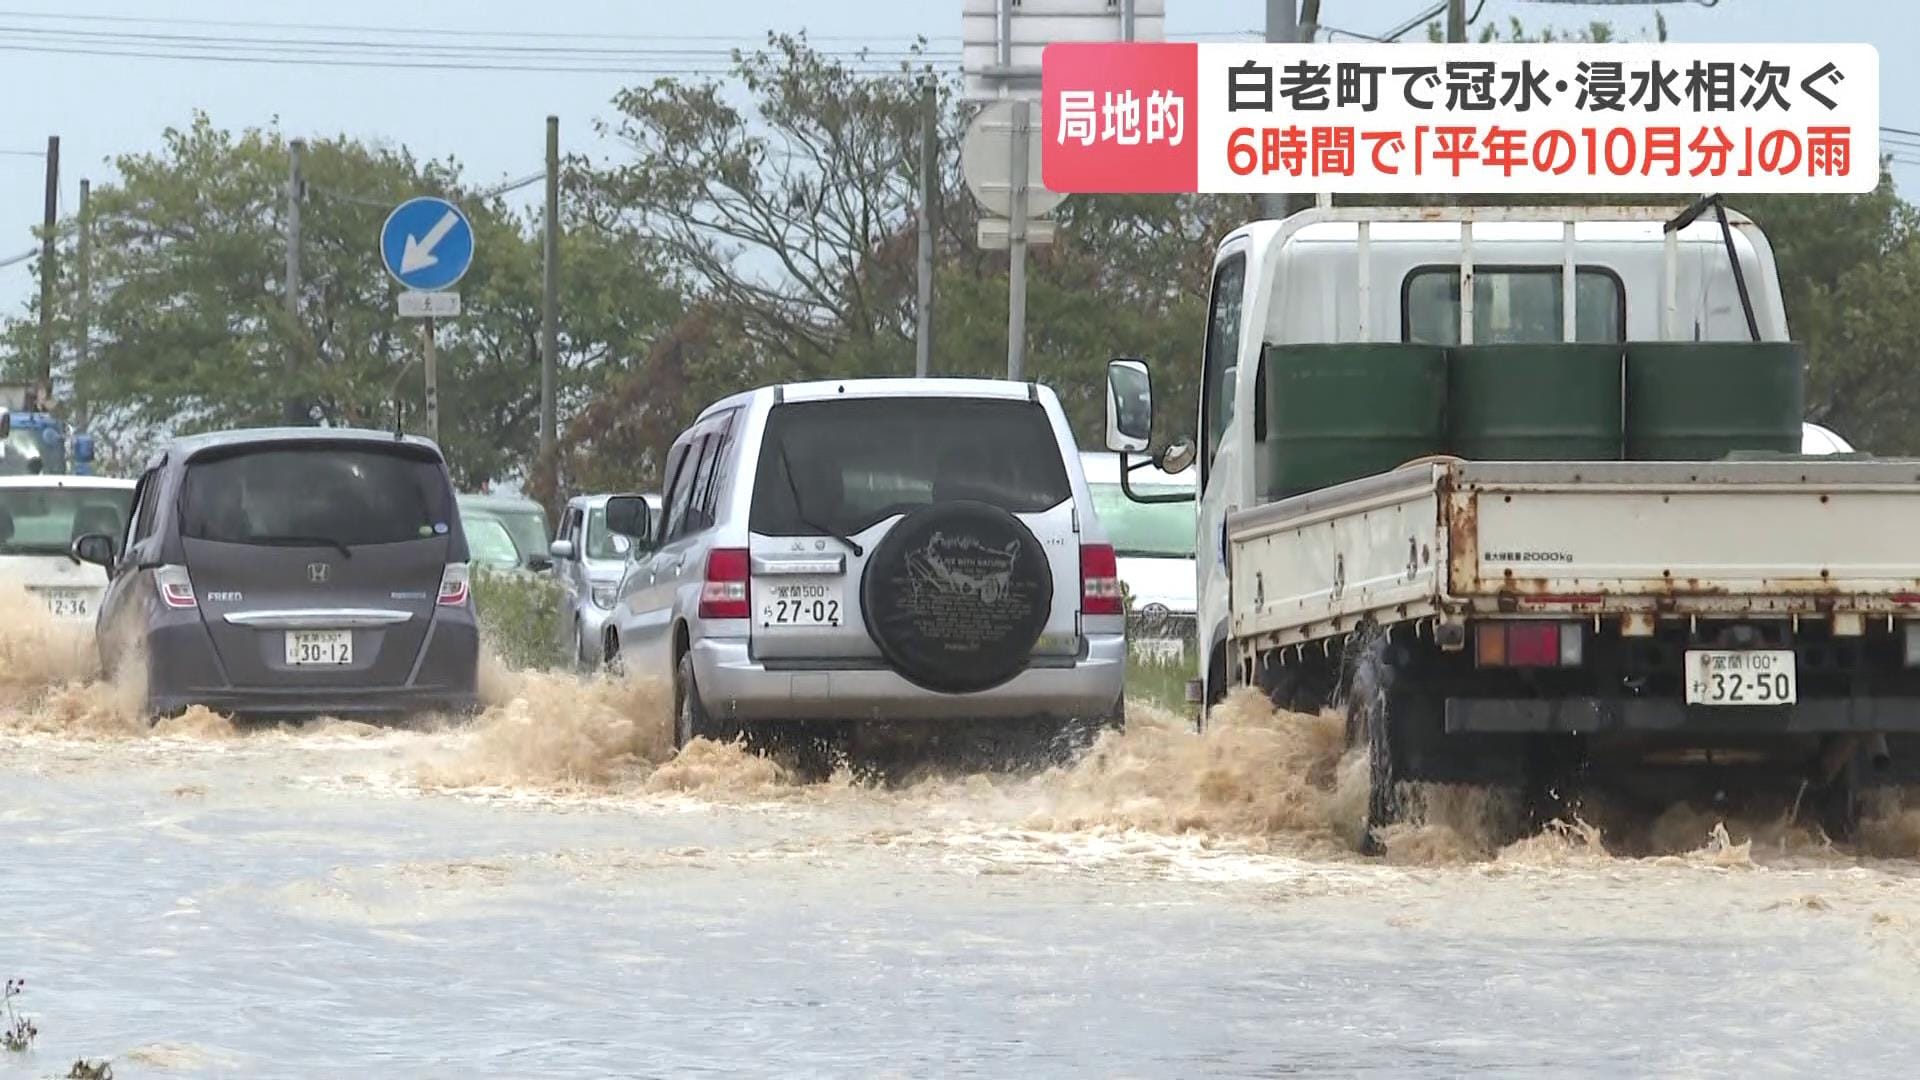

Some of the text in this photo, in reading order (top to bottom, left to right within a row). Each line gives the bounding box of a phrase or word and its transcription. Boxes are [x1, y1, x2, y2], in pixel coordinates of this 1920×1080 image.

[207, 591, 243, 601] FREED
[776, 599, 840, 623] 27-02
[301, 643, 349, 662] 30-12
[1711, 672, 1790, 701] 32-50
